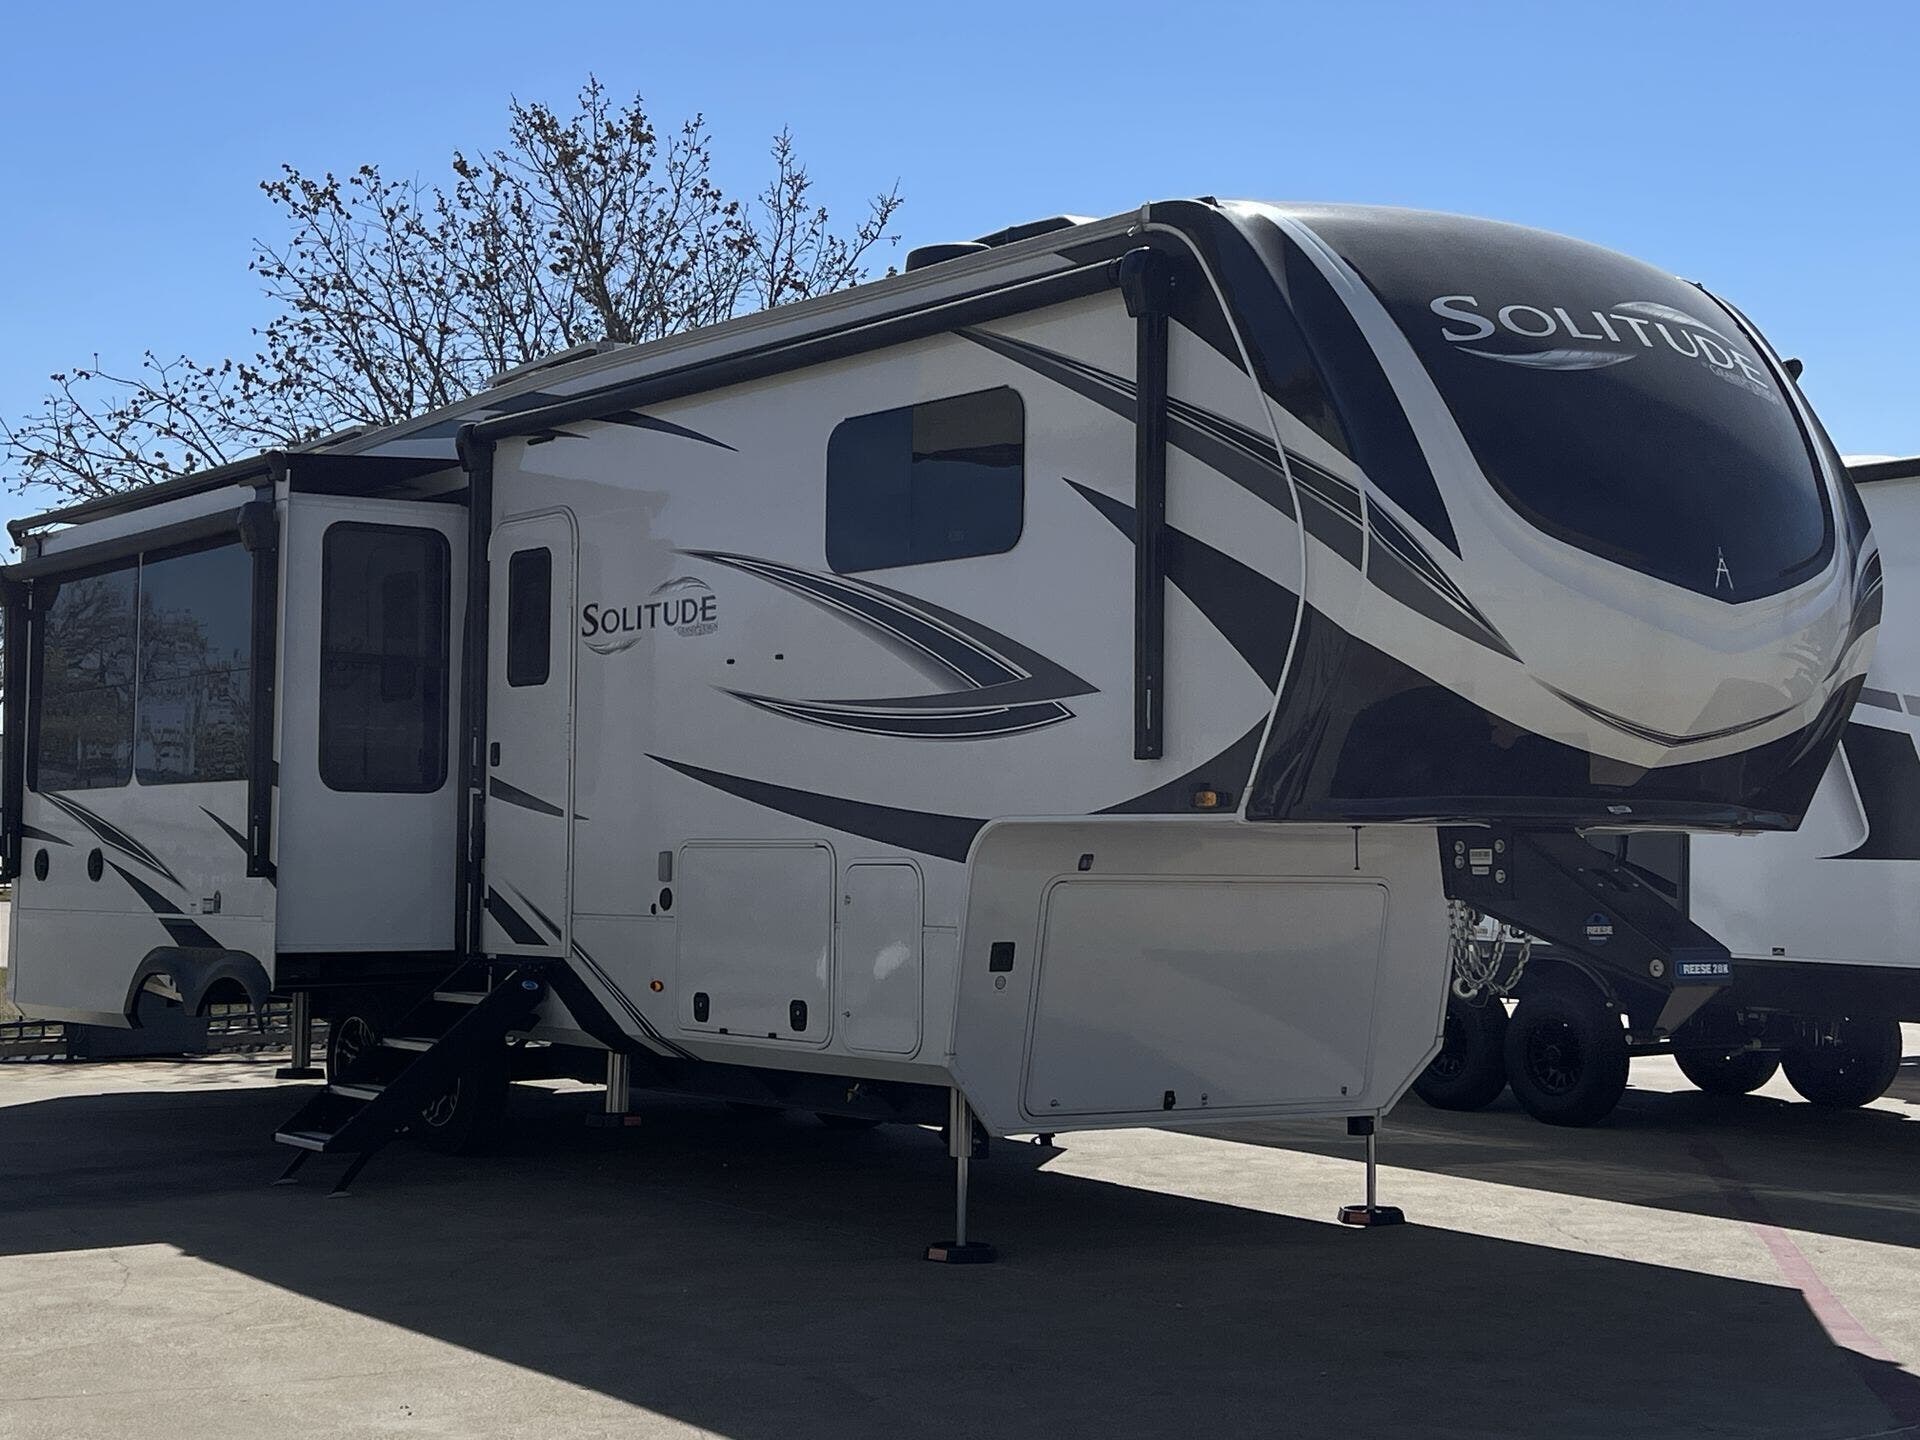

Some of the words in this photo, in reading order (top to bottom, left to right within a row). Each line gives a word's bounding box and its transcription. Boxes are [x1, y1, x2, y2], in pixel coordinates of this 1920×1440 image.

[1429, 295, 1769, 389] SOLITUDE
[581, 595, 717, 637] SOLITUDE
[1586, 925, 1613, 935] REESE
[1682, 963, 1712, 974] REESE
